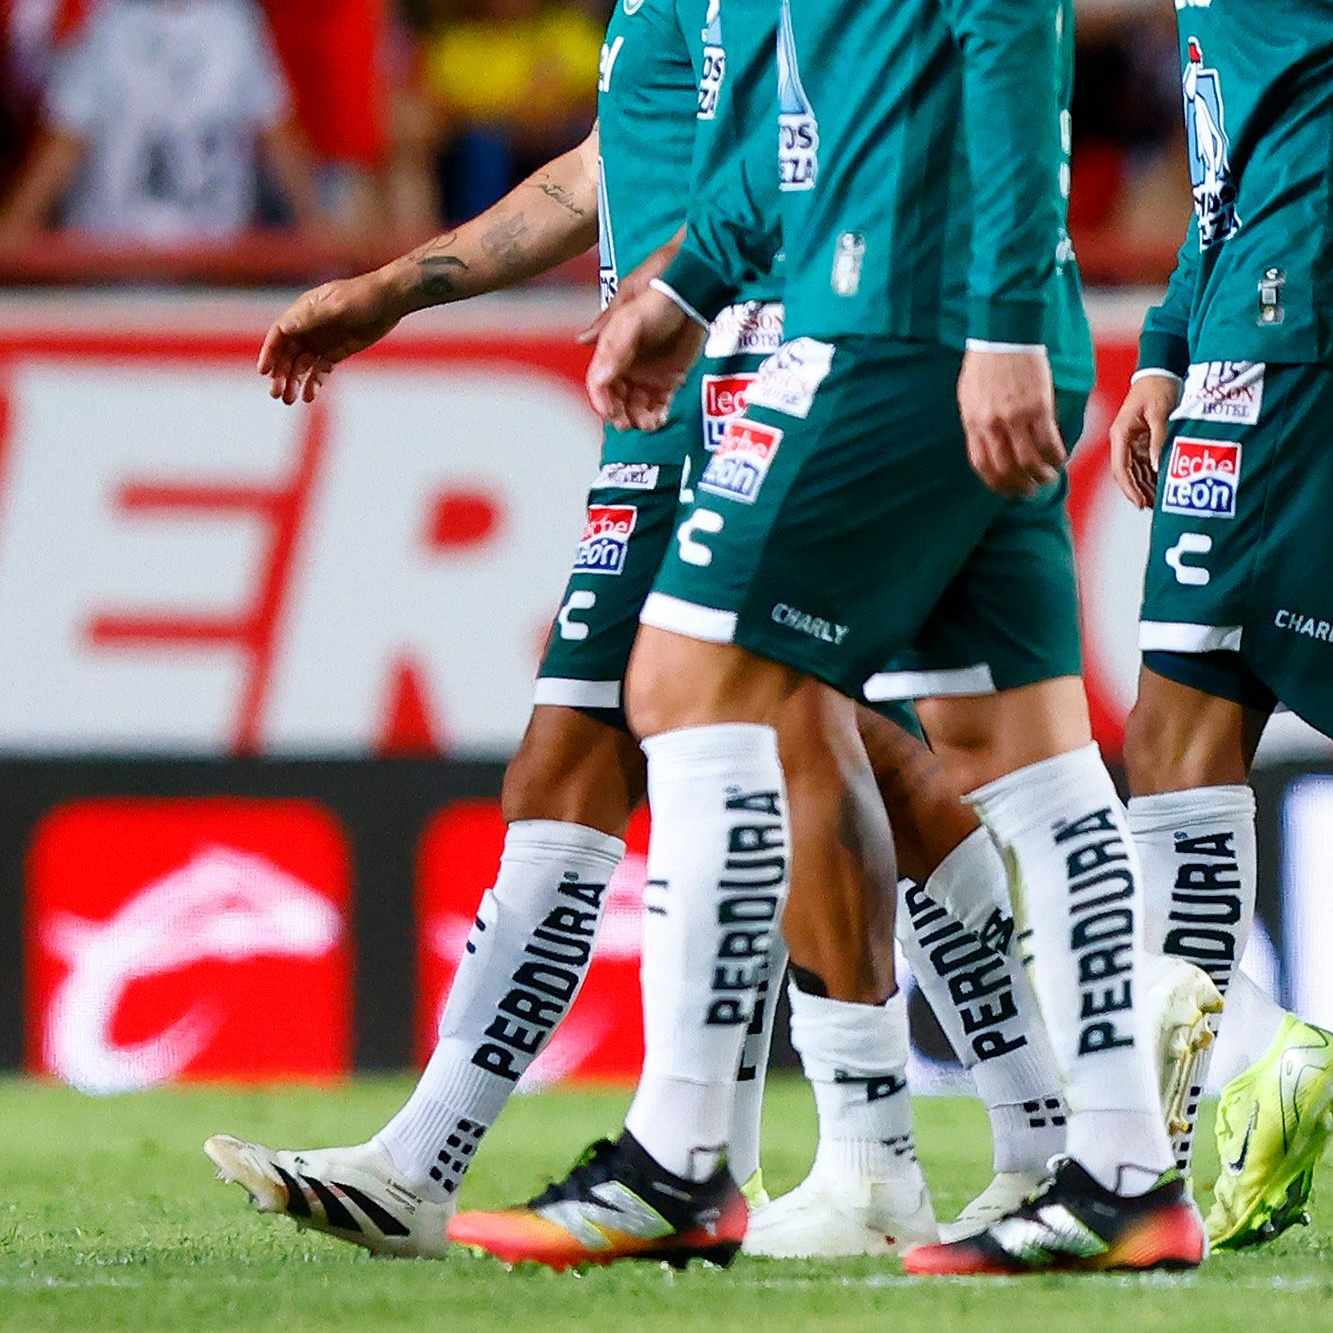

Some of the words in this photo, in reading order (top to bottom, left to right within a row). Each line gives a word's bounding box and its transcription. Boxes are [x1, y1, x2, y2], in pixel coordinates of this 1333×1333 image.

[1167, 478, 1231, 510] León
[1173, 446, 1234, 476] leche
[771, 603, 850, 645] CHARLY
[706, 788, 786, 1026] PERDURA
[1053, 806, 1136, 1059] PERDURA
[472, 869, 603, 1083] PERDURA
